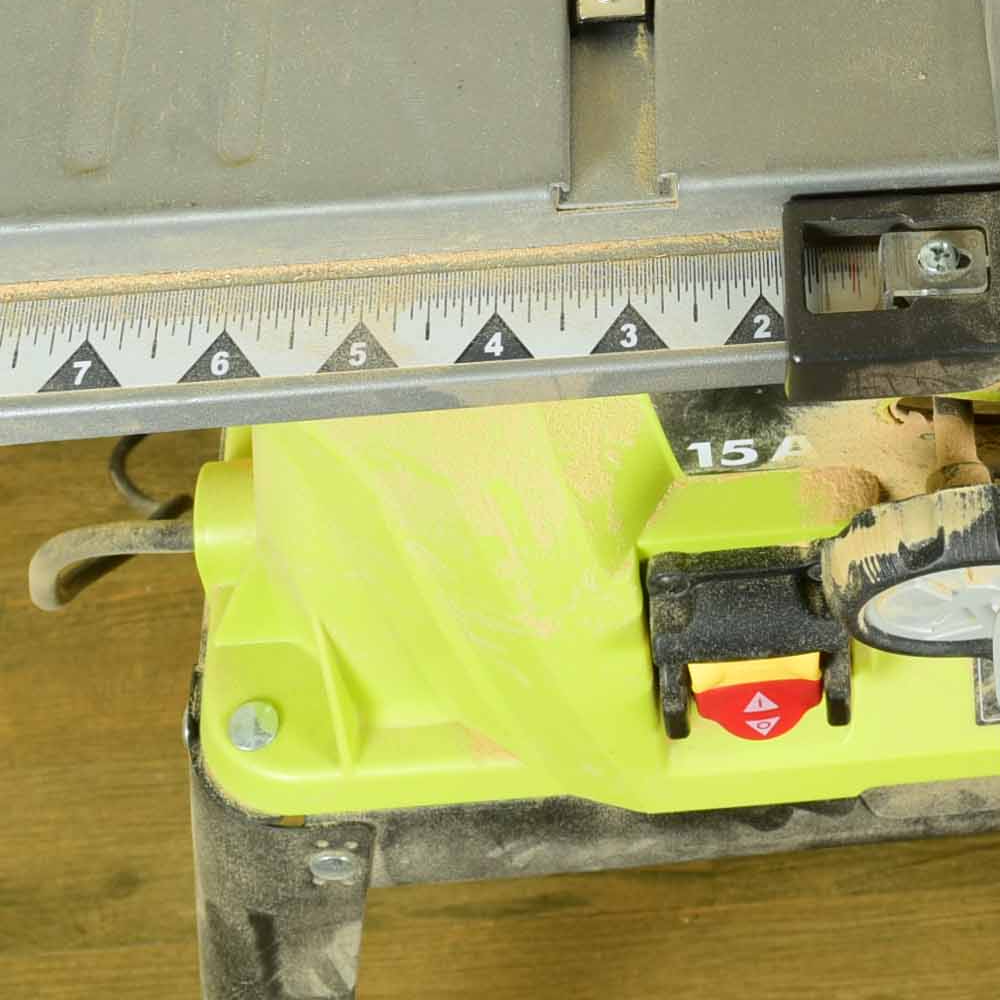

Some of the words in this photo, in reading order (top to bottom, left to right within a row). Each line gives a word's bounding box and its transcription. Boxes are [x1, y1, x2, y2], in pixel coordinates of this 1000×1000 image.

[619, 322, 639, 348] 3
[752, 314, 772, 339] 2
[348, 341, 367, 367] 5
[483, 331, 504, 358] 4
[72, 360, 92, 386] 7
[210, 350, 231, 377] 6
[686, 438, 759, 468] 15
